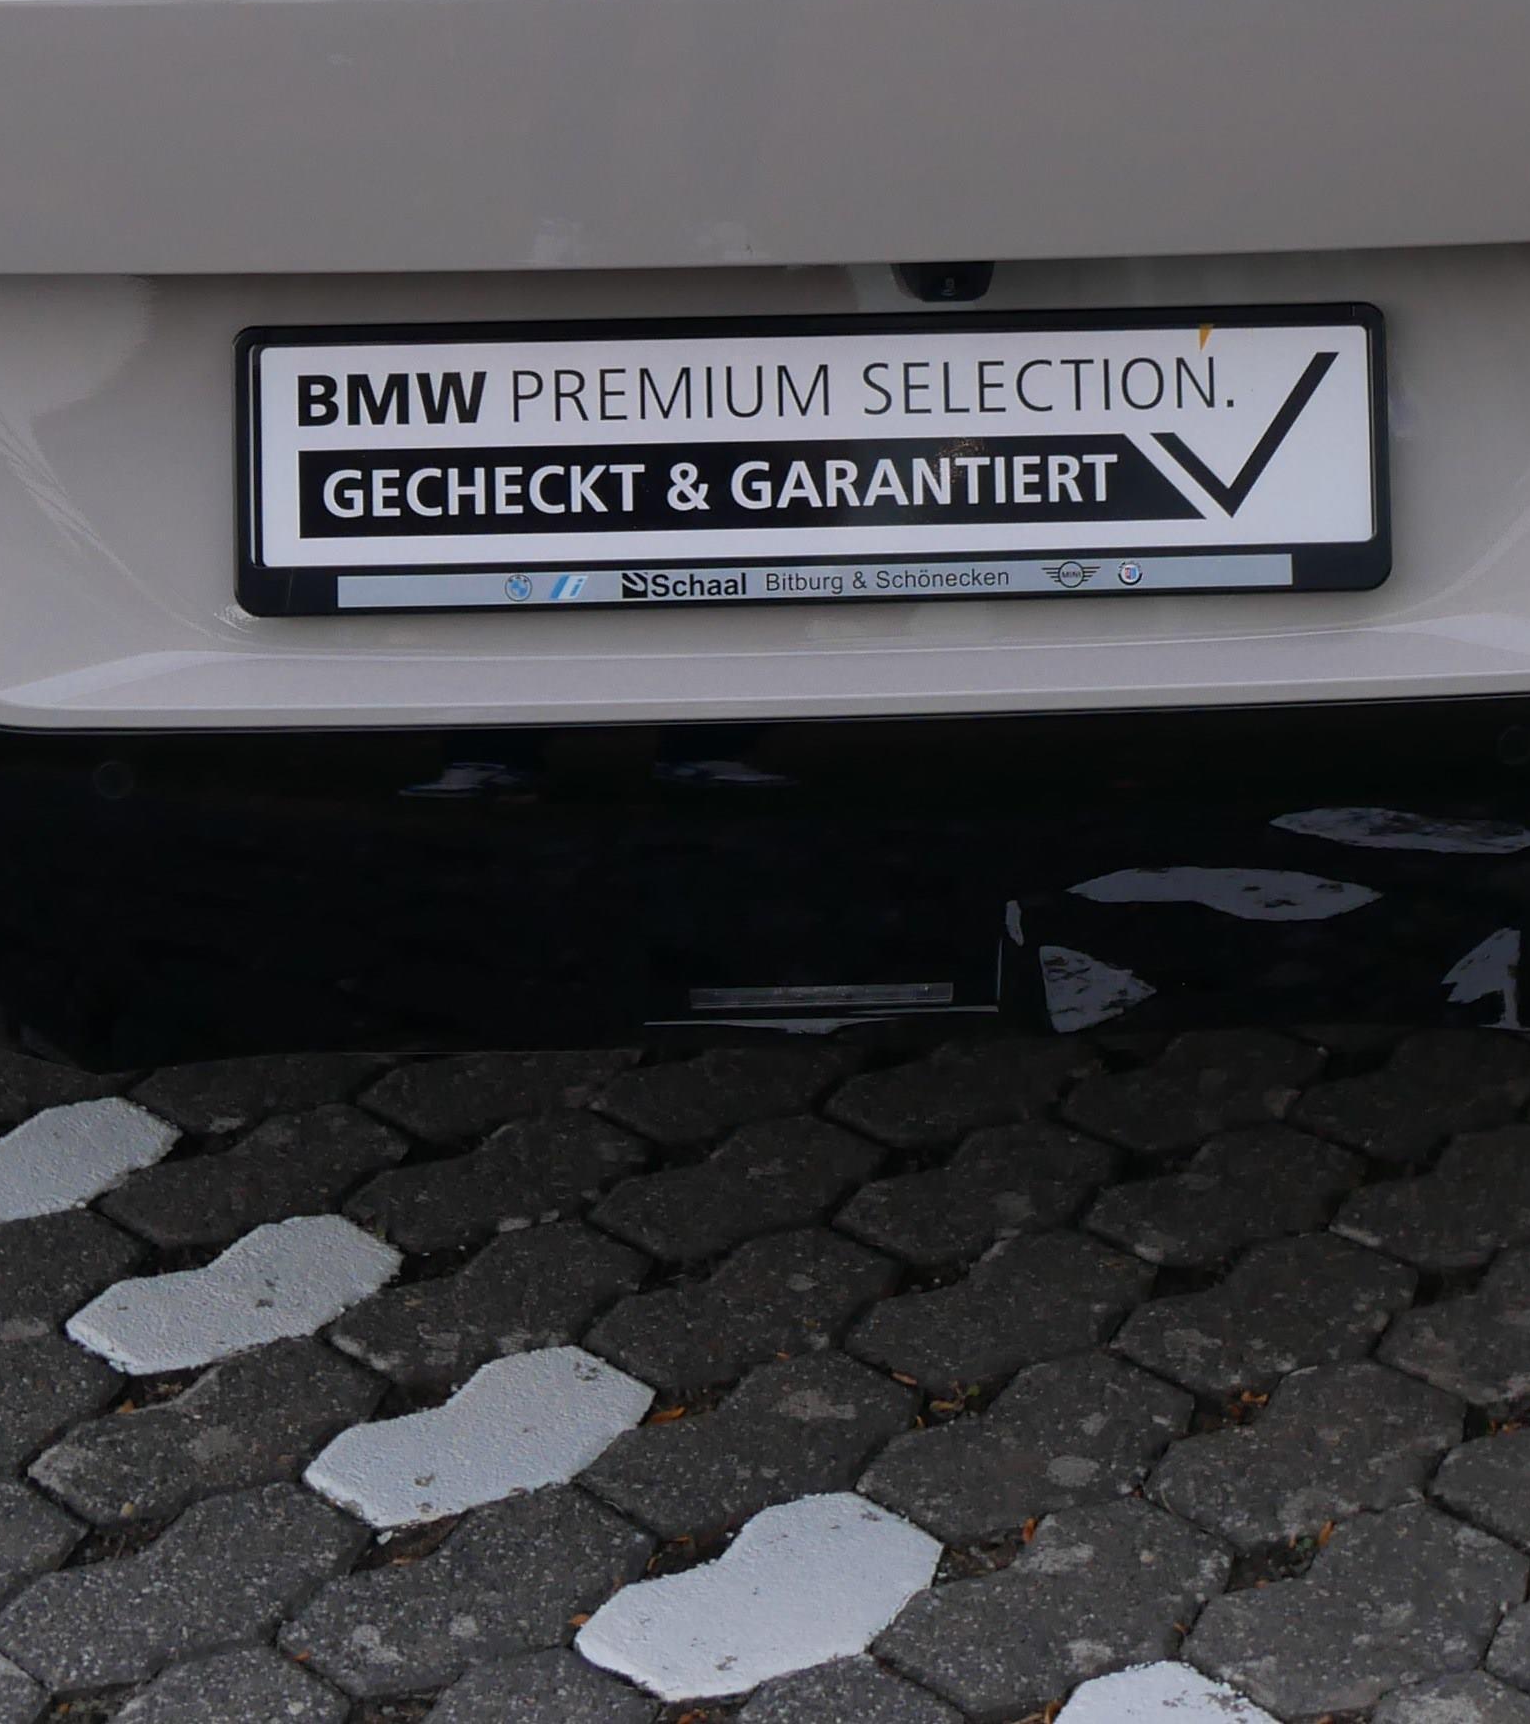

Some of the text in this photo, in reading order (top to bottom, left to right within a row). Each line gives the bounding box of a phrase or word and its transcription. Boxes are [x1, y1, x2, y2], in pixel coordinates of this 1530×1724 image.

[296, 356, 1235, 428] BMW PREMIUM SELECTION.
[322, 453, 1119, 518] GECHECKT & GARANTIERT
[650, 572, 747, 597] Schaal
[765, 568, 1010, 594] Bitburg & Schönecken
